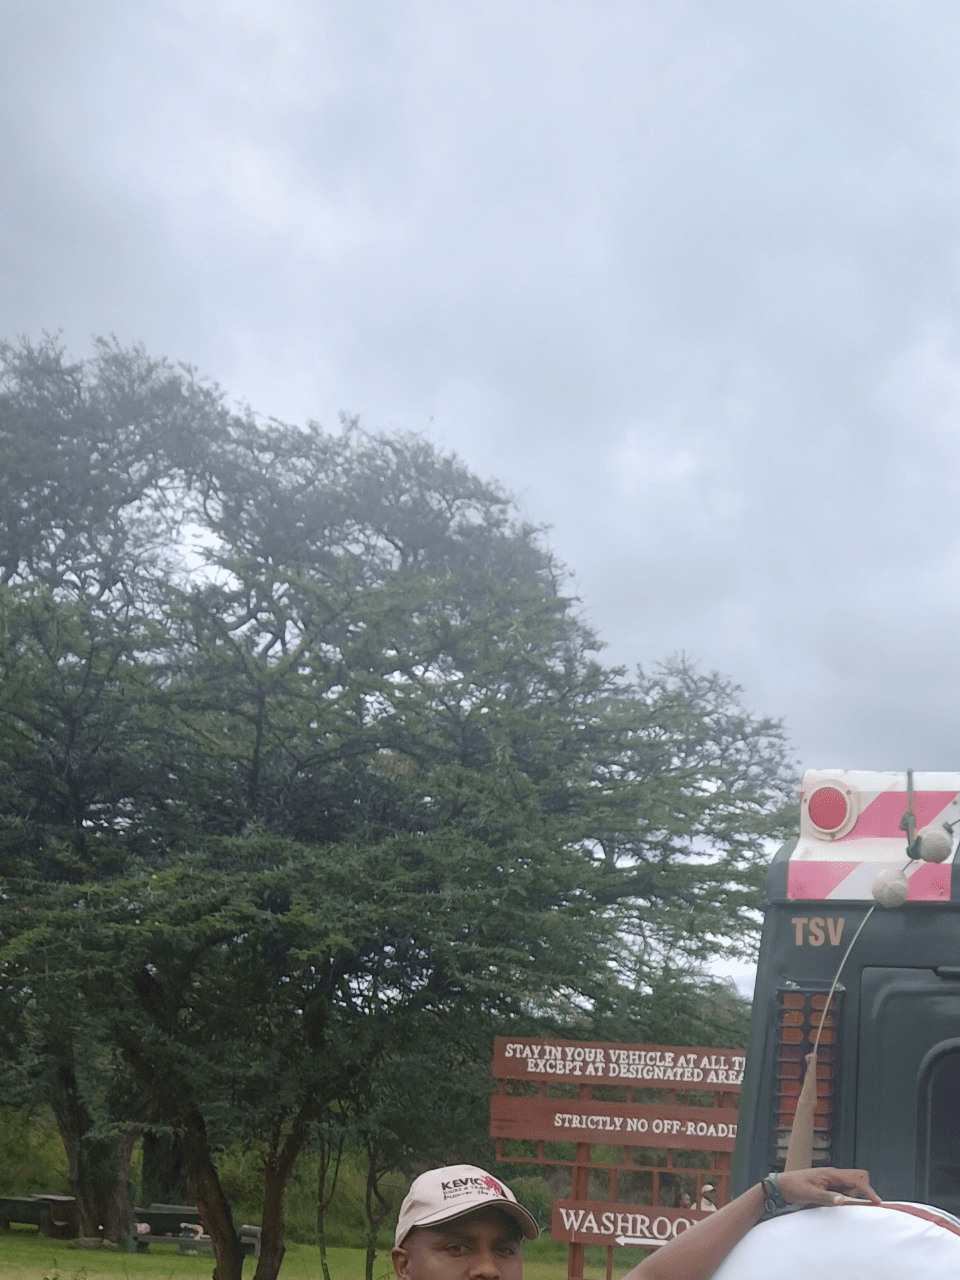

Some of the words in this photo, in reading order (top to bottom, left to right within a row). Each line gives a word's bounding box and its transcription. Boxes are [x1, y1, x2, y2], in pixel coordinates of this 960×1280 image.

[791, 917, 845, 947] TSV
[505, 1043, 541, 1058] STAY
[544, 1045, 562, 1060] IN
[565, 1047, 605, 1062] YOUR
[609, 1049, 675, 1067] VEHICLE
[677, 1054, 697, 1068] AT
[700, 1055, 729, 1069] ALL
[527, 1058, 583, 1075] EXCEPT
[585, 1062, 605, 1076] AT
[609, 1063, 703, 1082] DESIGNATED
[554, 1113, 624, 1130] STRICTLY
[627, 1118, 648, 1132] NO
[652, 1119, 738, 1138] OFF-ROADI
[441, 1177, 483, 1190] KEVIC
[559, 1208, 697, 1239] WASHROO
